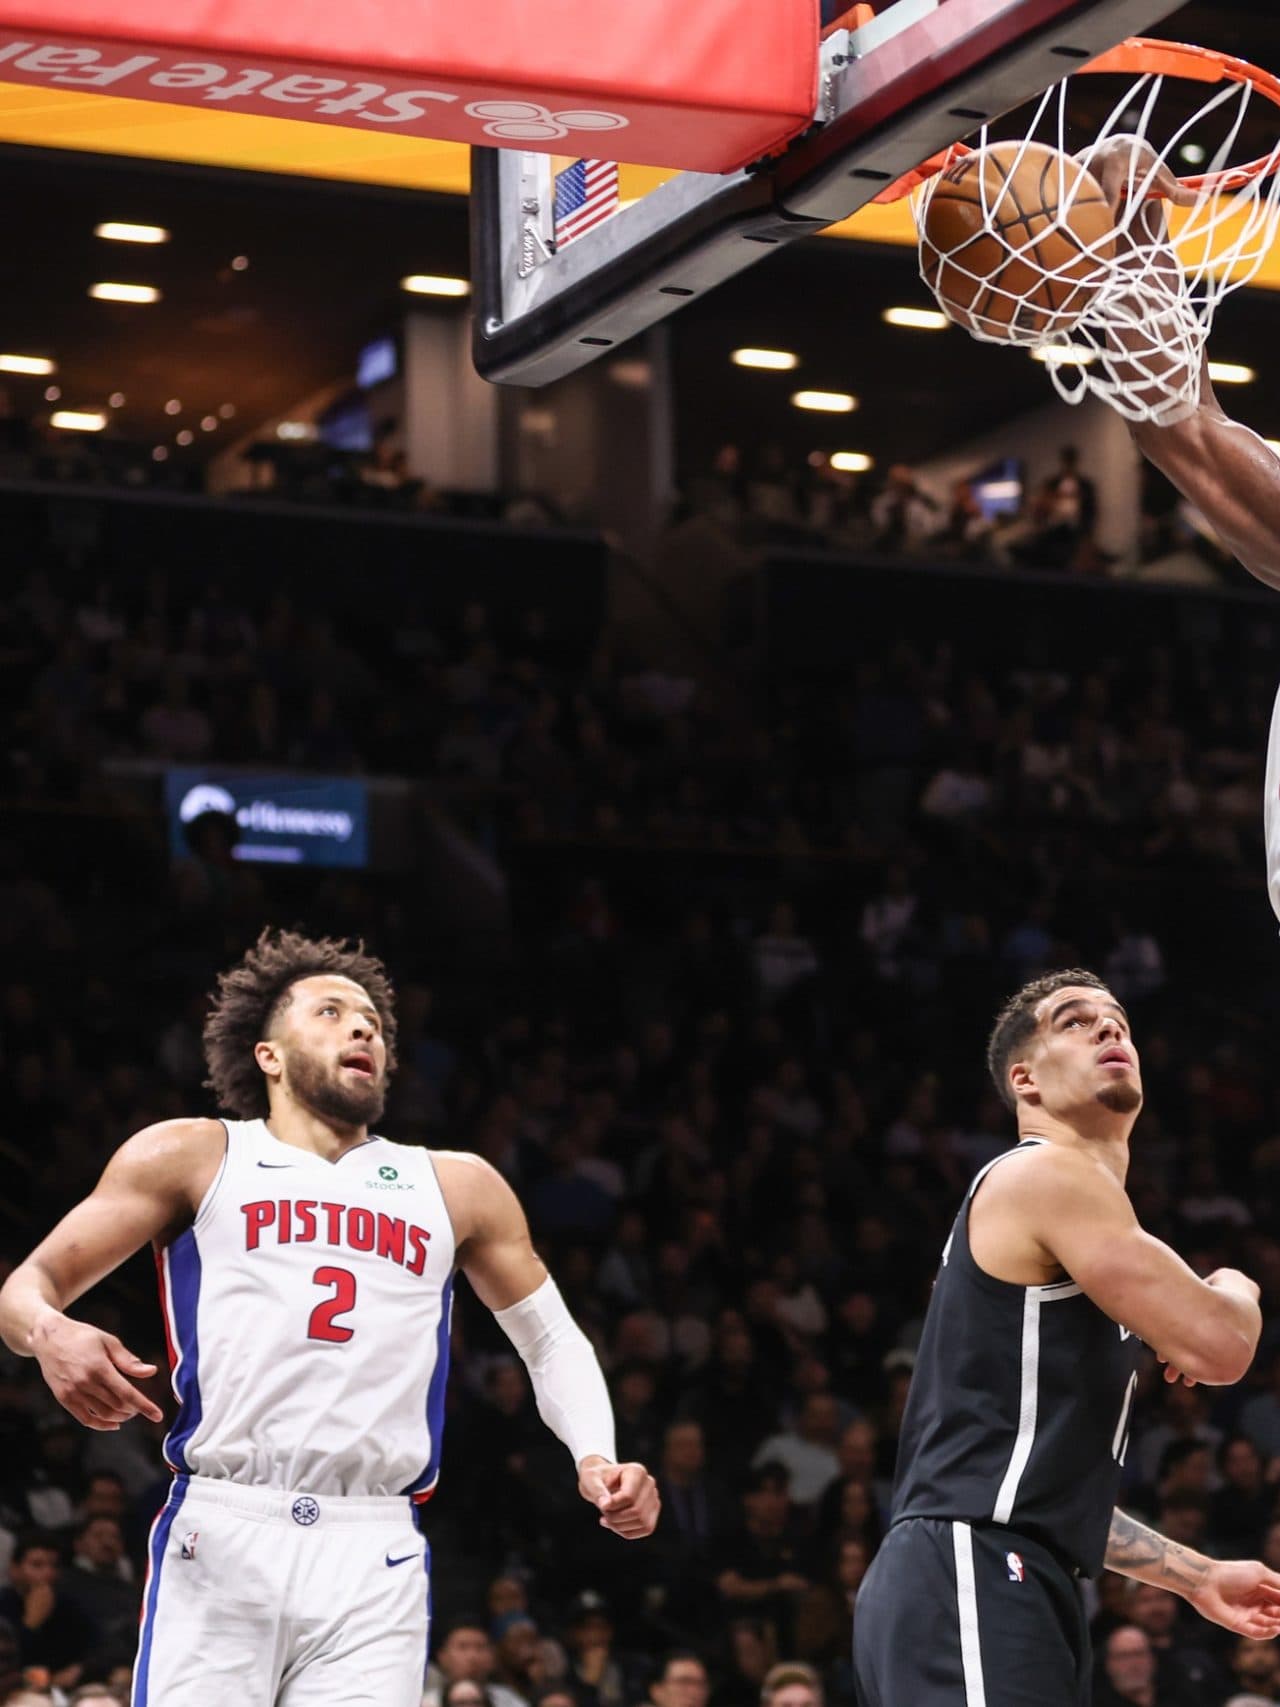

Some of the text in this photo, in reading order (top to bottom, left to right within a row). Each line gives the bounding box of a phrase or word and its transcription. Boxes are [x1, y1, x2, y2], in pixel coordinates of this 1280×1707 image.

[149, 62, 459, 123] State
[240, 1200, 431, 1277] PISTONS
[307, 1266, 357, 1343] 2
